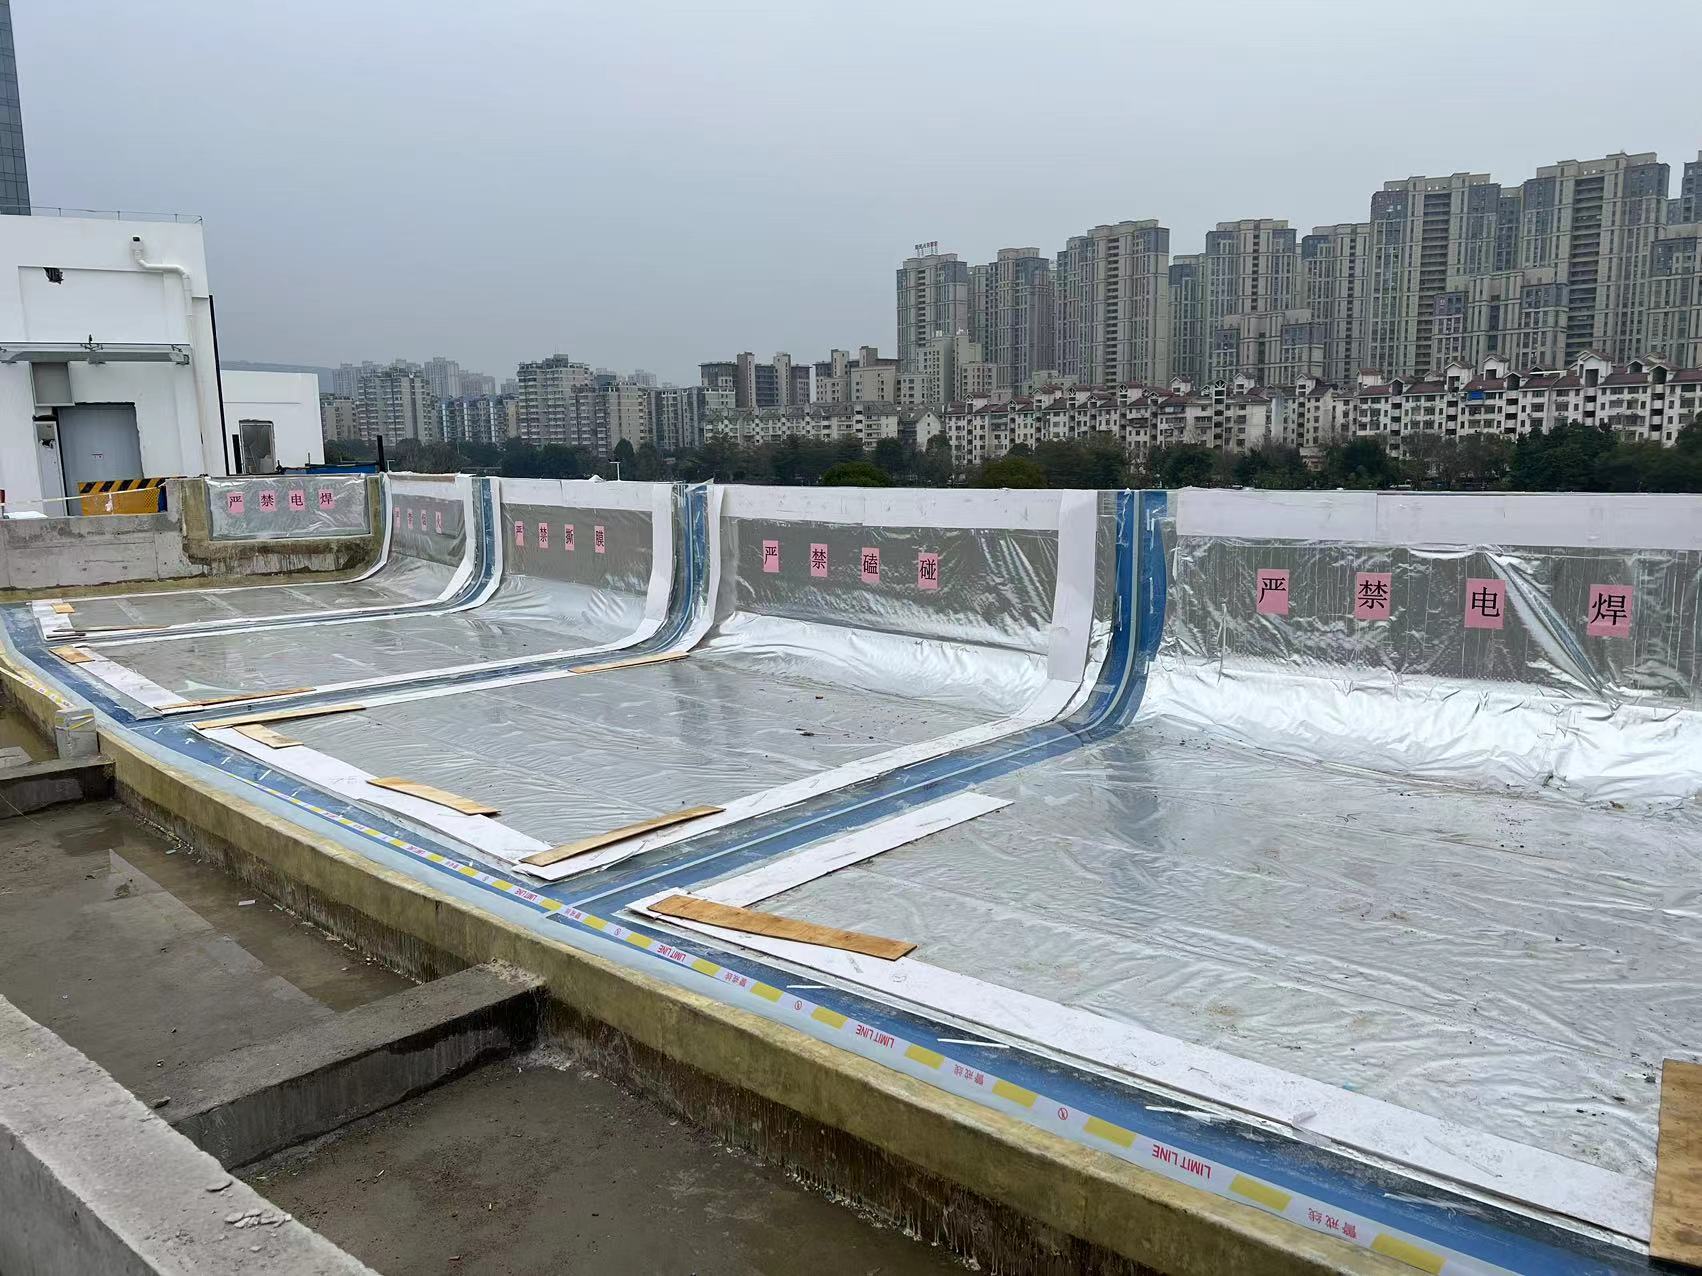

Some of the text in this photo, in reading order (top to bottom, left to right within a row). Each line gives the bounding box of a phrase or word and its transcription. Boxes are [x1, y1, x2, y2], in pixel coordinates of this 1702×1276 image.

[228, 493, 334, 508] 严禁电焊
[516, 525, 605, 547] 严禁撕膜
[764, 546, 937, 581] 严禁磕碰
[1258, 577, 1628, 626] 严禁电焊
[657, 944, 687, 962] LIMIT LINE
[856, 1024, 895, 1048] LIMIT LINE
[954, 1064, 984, 1086] 警戒线
[1152, 1144, 1212, 1179] LIMIT LINE
[1308, 1207, 1357, 1239] 警戒线
